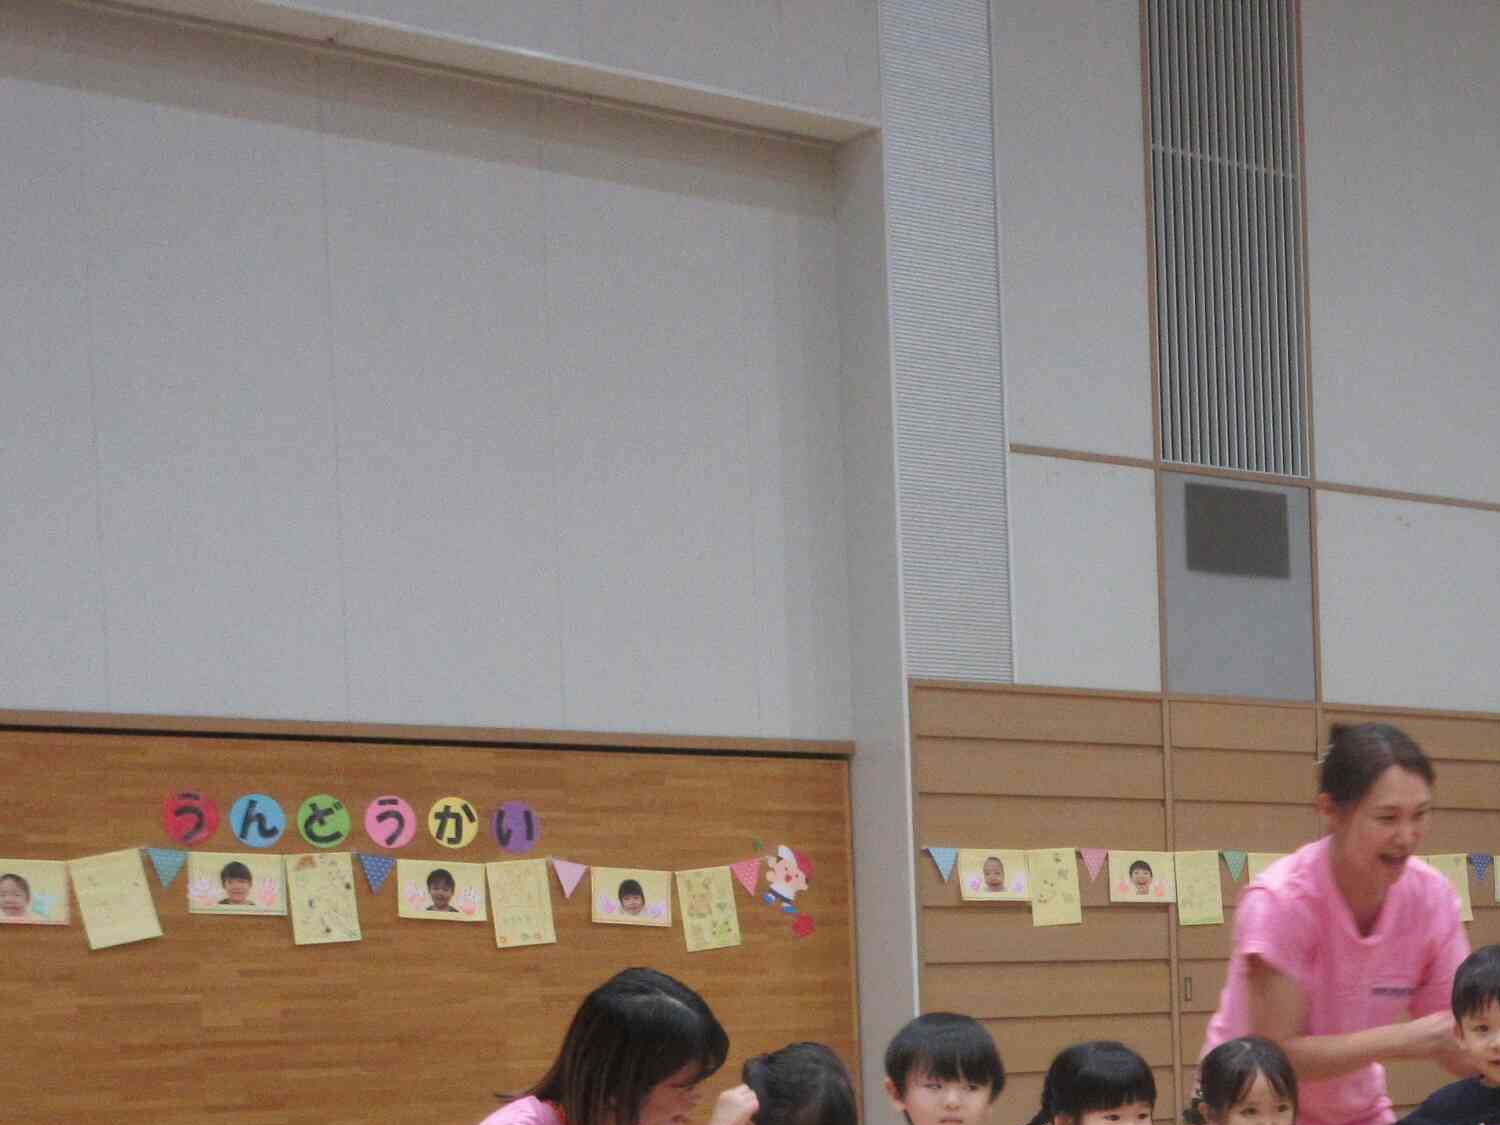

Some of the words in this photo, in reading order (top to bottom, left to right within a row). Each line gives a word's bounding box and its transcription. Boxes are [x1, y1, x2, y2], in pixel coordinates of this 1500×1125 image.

[174, 793, 535, 848] うんどうかい
